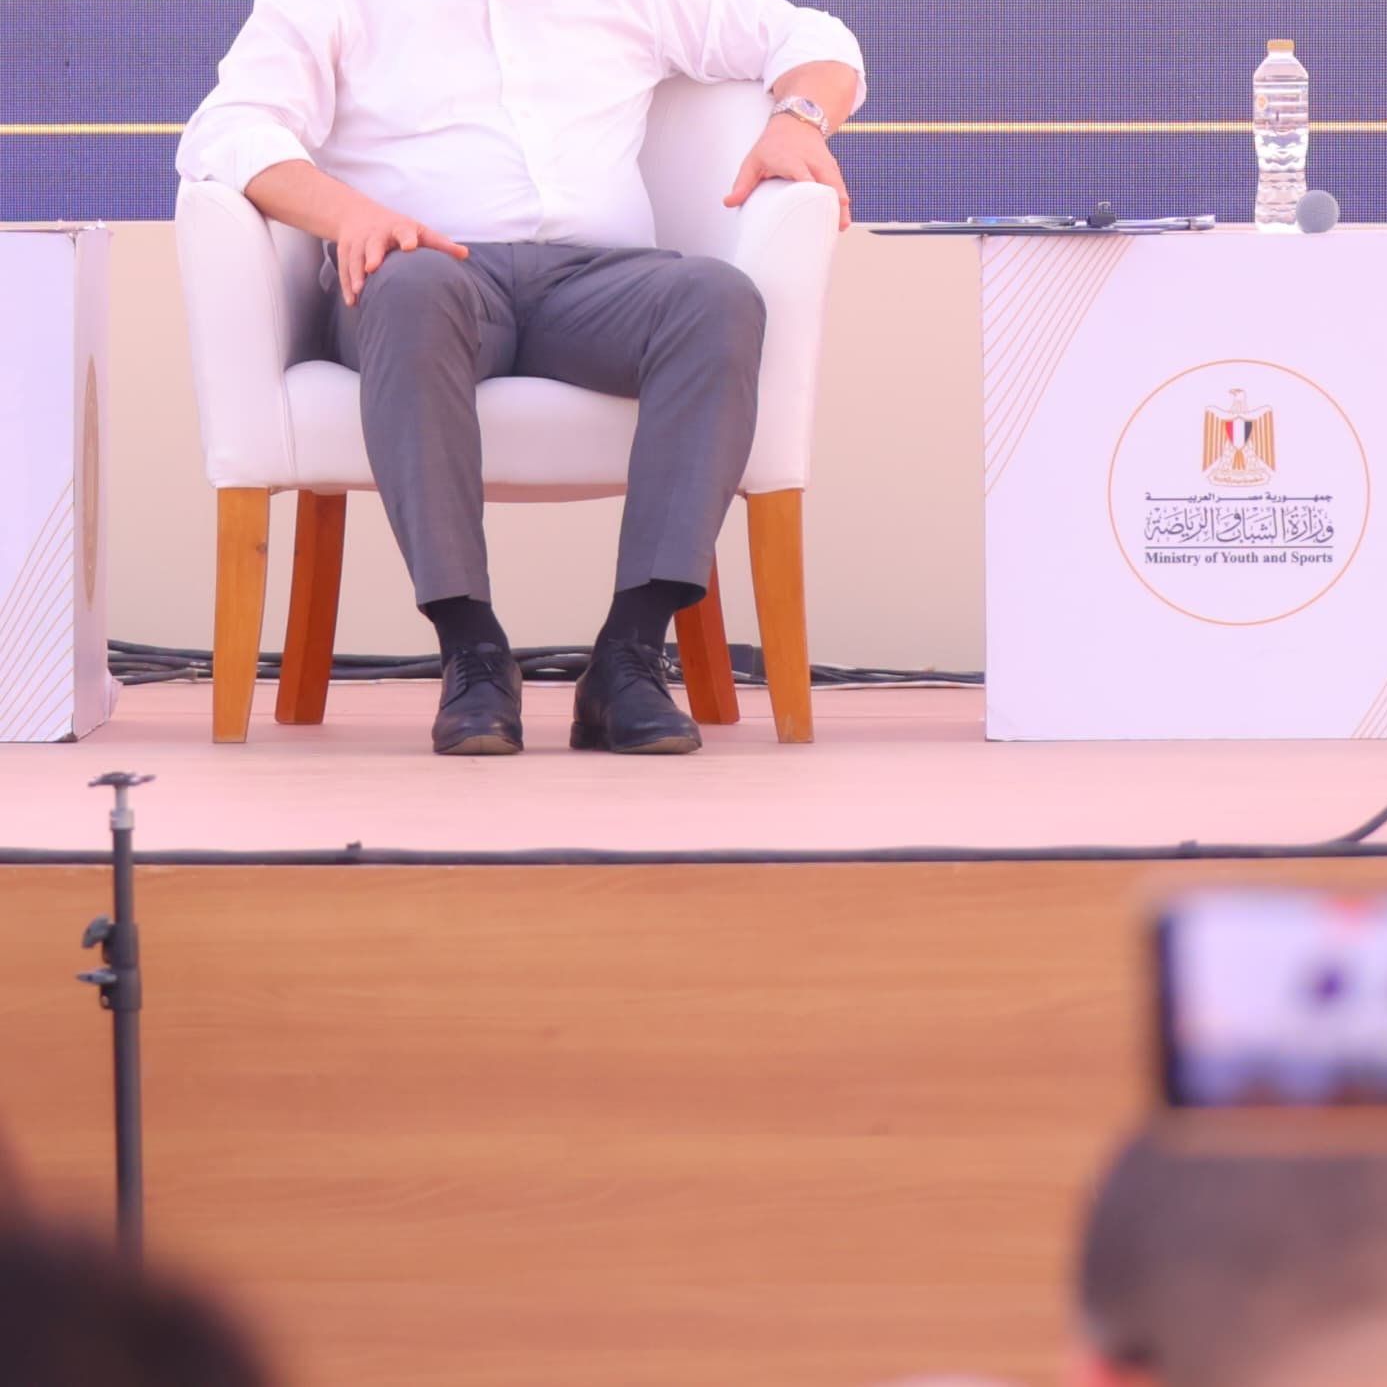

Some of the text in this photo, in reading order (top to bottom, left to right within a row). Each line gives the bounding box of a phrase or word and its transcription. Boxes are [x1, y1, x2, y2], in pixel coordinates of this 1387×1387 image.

[1144, 551, 1333, 566] Ministry of Youth and Sports
